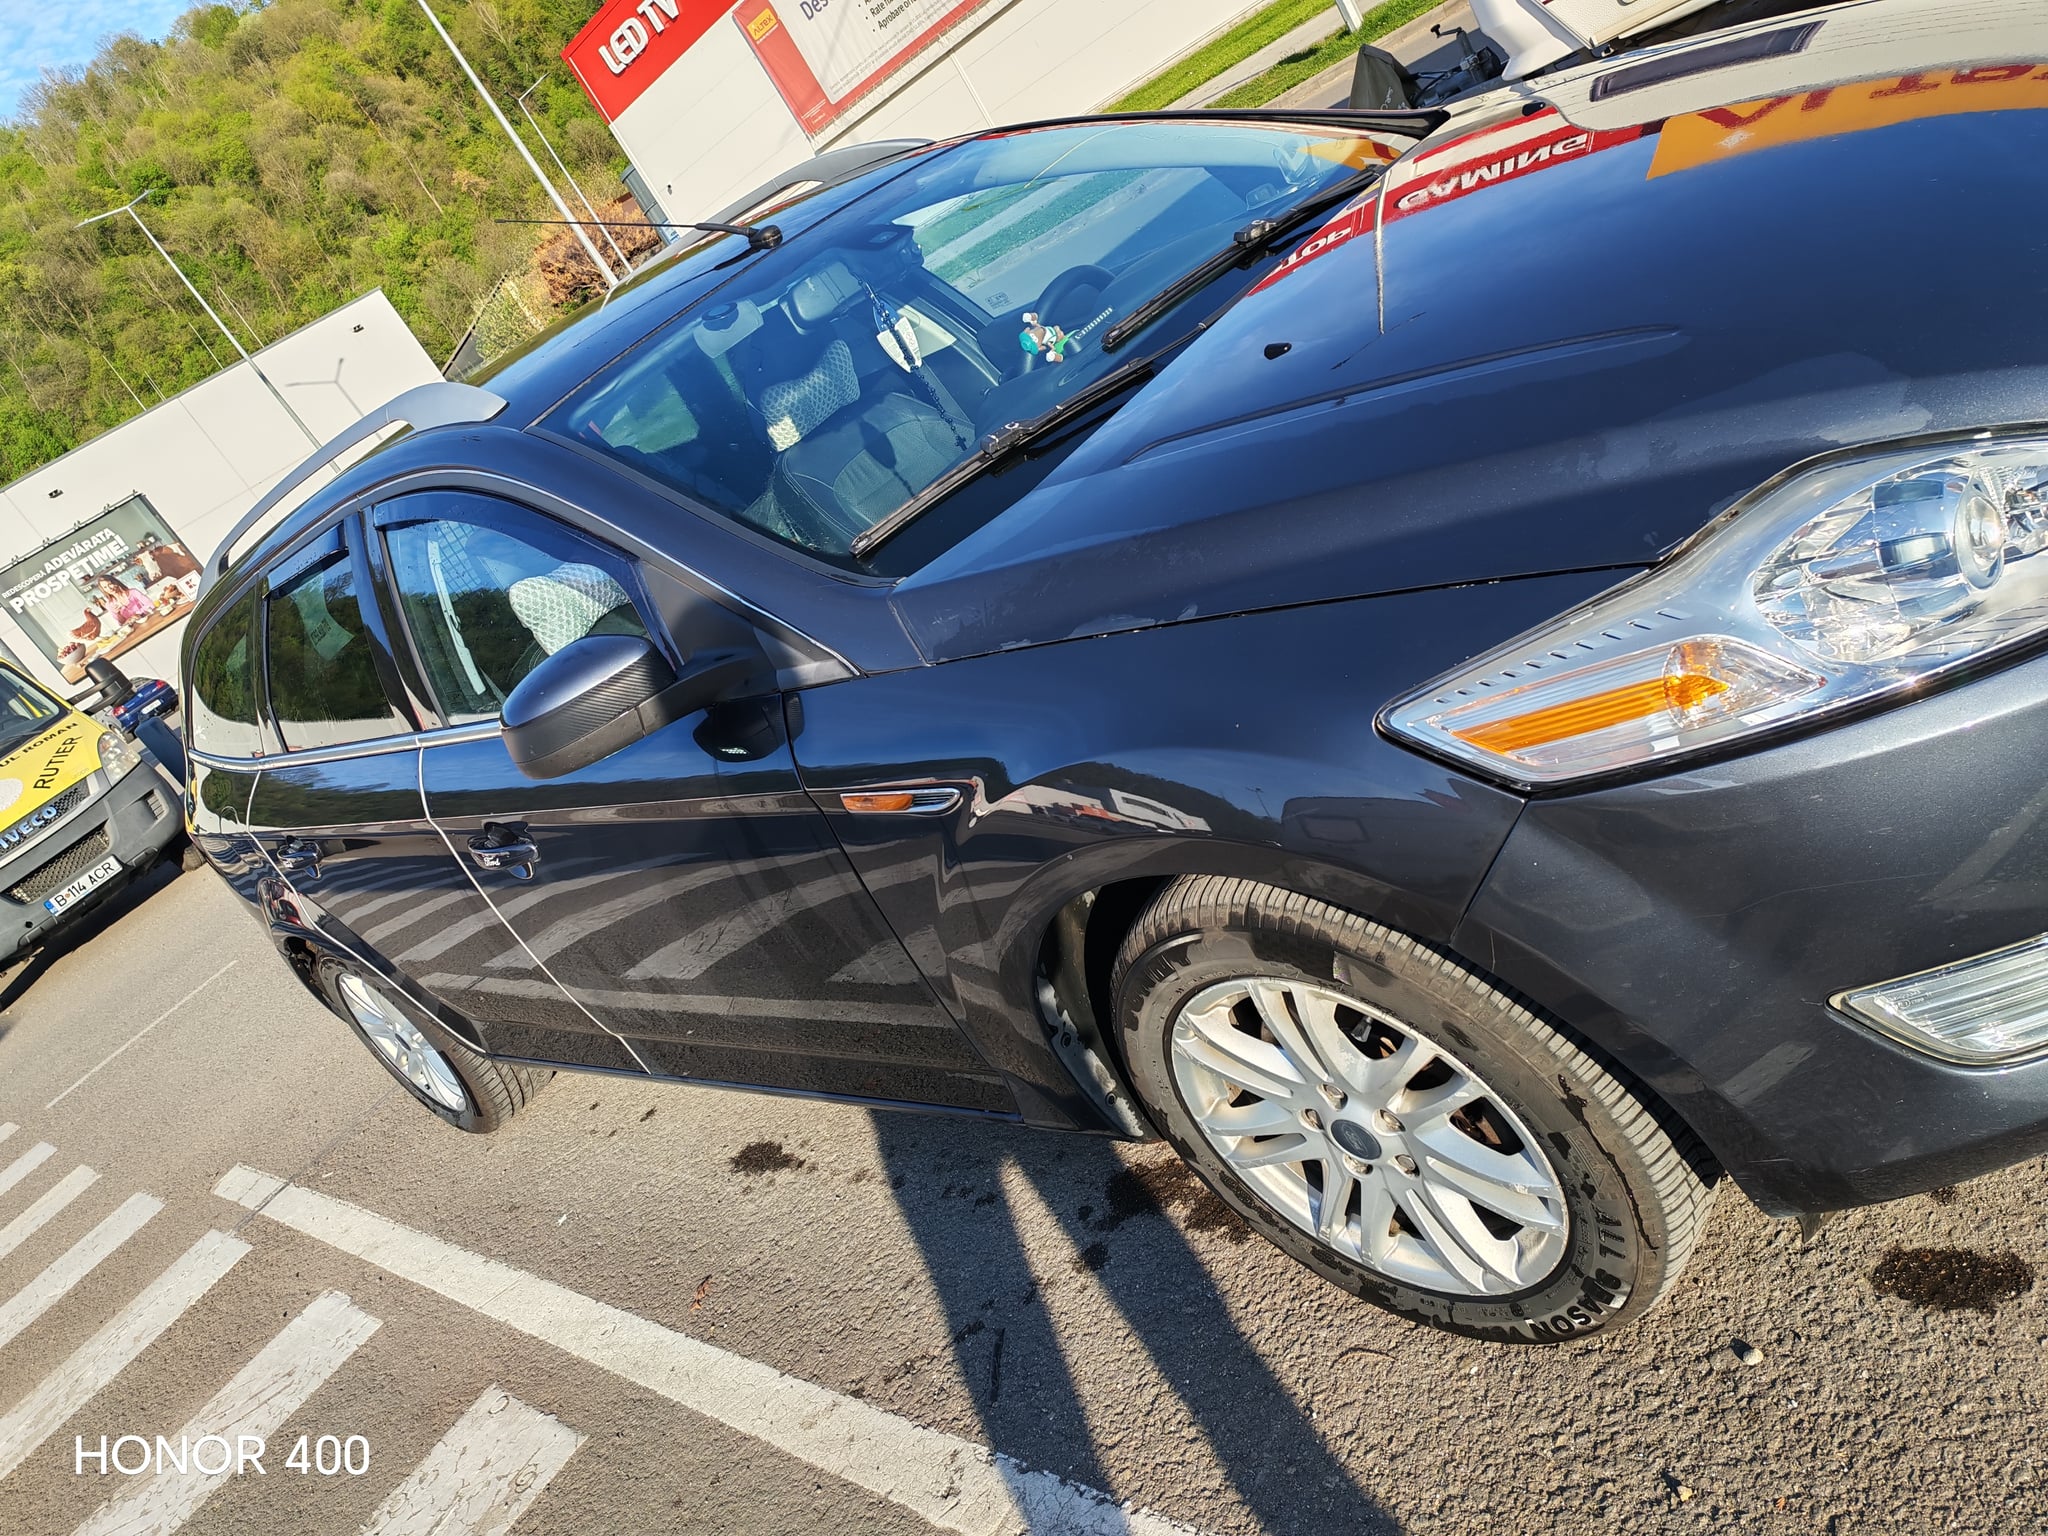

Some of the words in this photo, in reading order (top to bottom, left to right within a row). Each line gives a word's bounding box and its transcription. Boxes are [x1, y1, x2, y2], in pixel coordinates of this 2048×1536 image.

[870, 2, 886, 17] Rate
[878, 4, 905, 30] Aprobare
[598, 17, 649, 74] LED
[636, 0, 680, 34] TV
[43, 528, 115, 574] ADEVĂRATA
[22, 722, 79, 753] ROMAN
[33, 736, 83, 789] RUTIER
[0, 806, 57, 849] IVECO
[67, 881, 87, 898] 114
[87, 862, 115, 885] ACR
